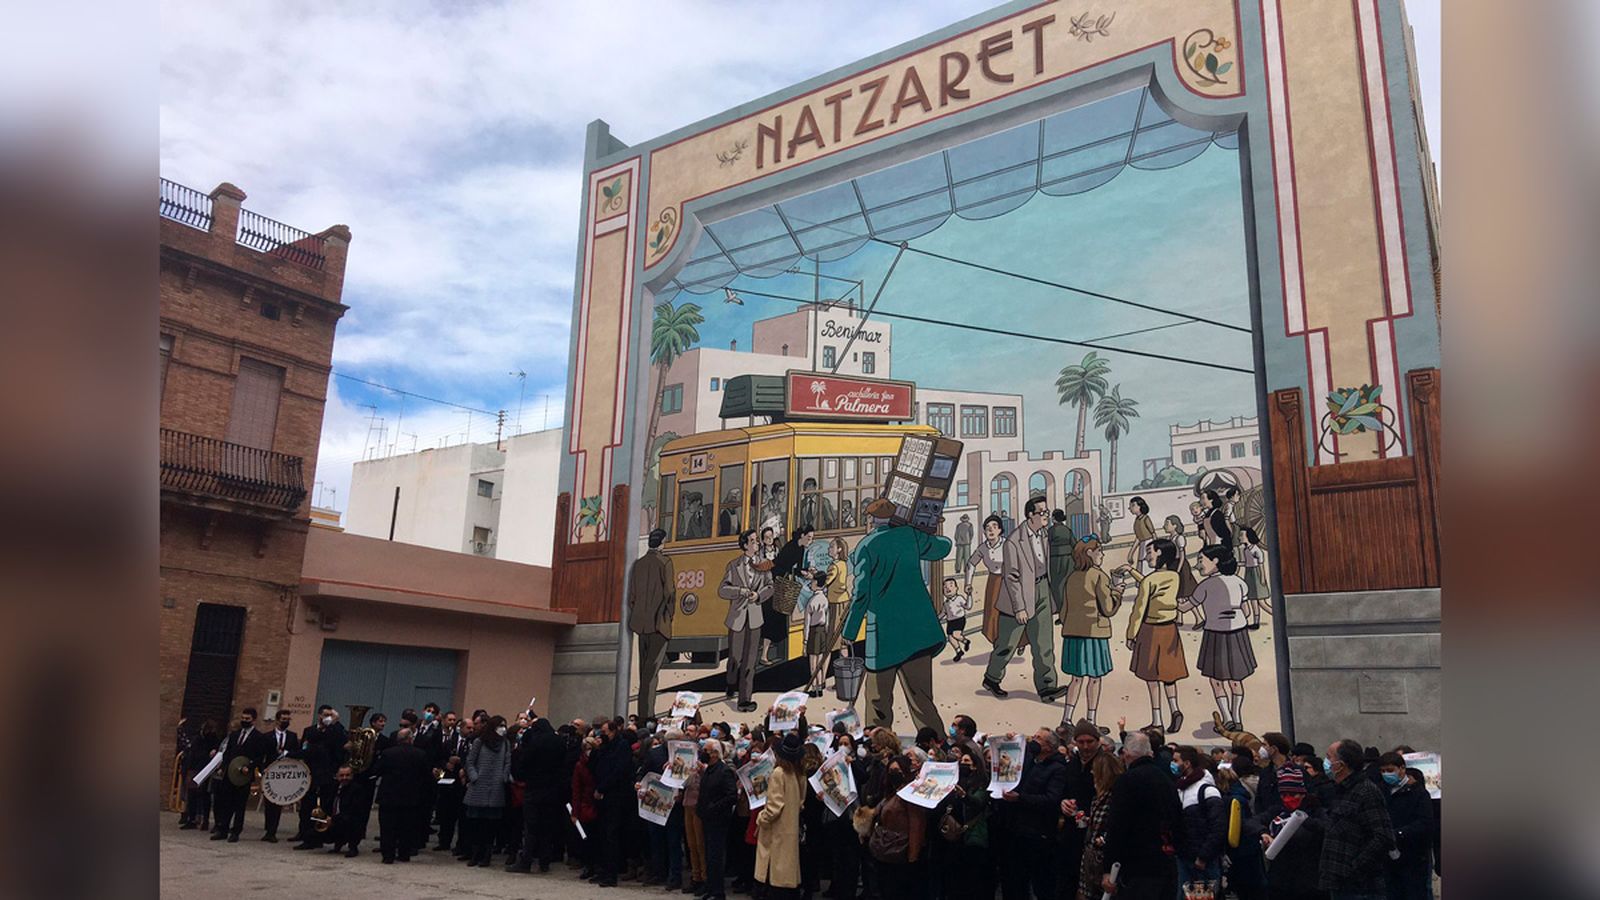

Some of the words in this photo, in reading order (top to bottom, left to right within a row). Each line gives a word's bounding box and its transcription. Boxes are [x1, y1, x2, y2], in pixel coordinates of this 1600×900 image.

[755, 14, 1056, 170] NATZARET
[821, 319, 882, 343] Benimar
[834, 394, 890, 414] Palmera
[693, 458, 703, 469] 14
[677, 569, 705, 589] 238
[295, 695, 305, 703] NO
[265, 771, 308, 780] NATZARET
